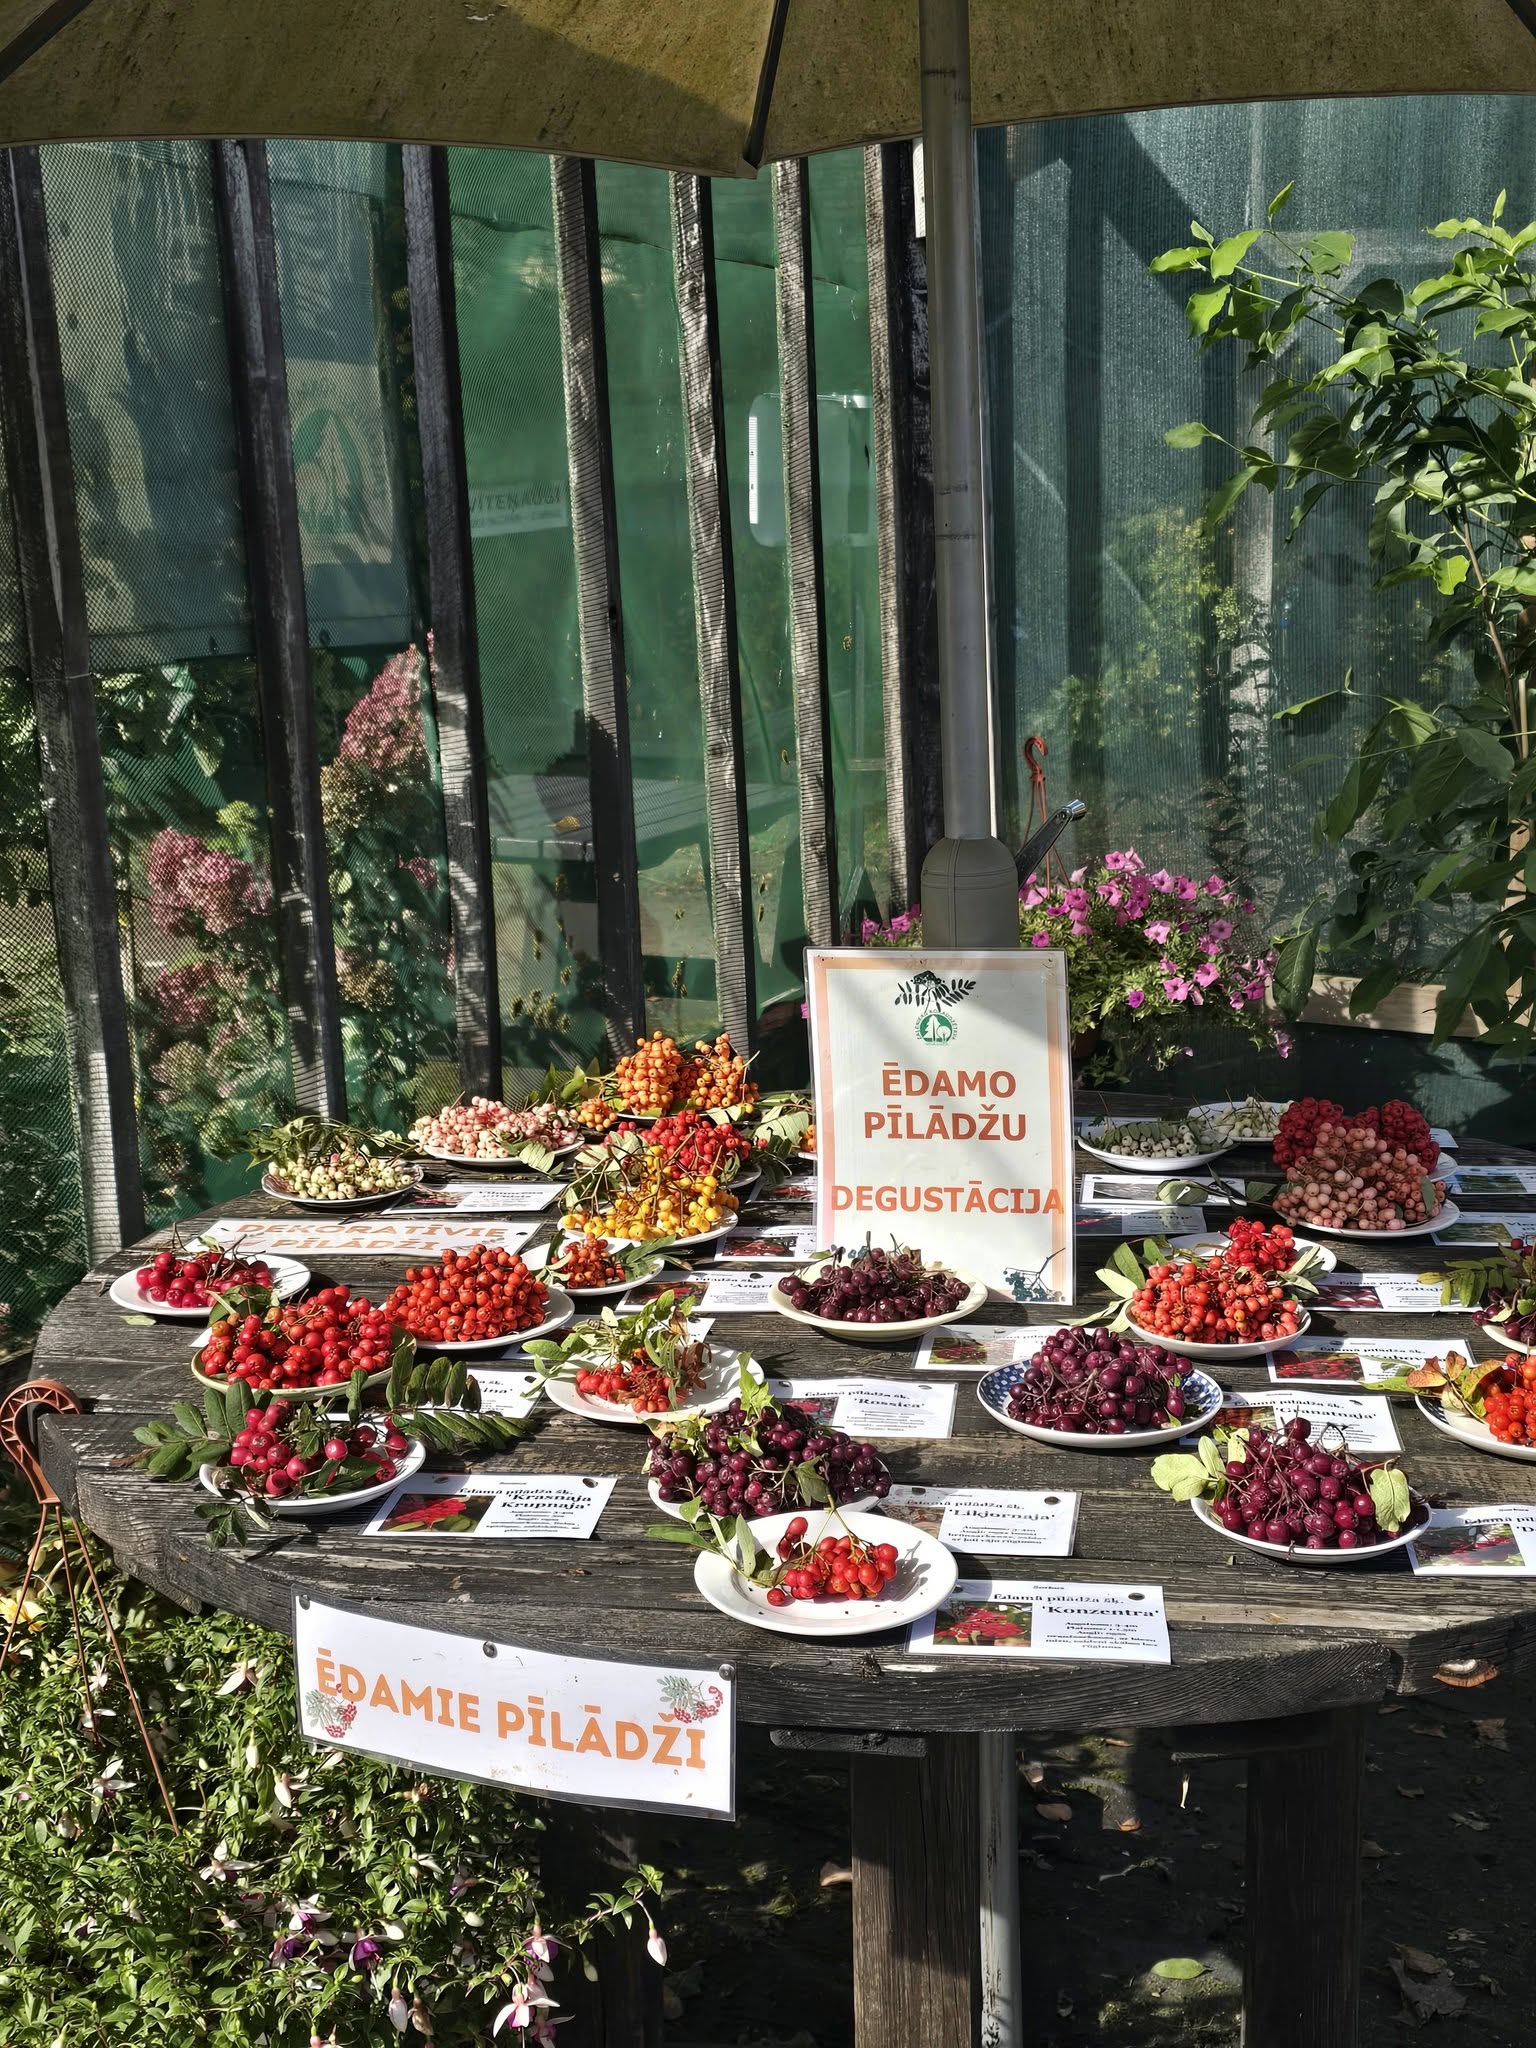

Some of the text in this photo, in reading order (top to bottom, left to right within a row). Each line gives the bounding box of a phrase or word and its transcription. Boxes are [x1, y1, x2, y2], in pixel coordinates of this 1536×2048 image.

[881, 1062, 1016, 1098] ĒDAMO
[864, 1104, 1026, 1141] PĪLĀDŽU
[831, 1180, 1064, 1215] DEGUSTĀCIJA
[236, 1223, 509, 1238] DEKORATĪVIE
[271, 1237, 440, 1251] PĪLĀDŽI
[854, 1398, 925, 1408] 'Rossica'
[501, 1501, 591, 1509] Krupnaja'
[508, 1494, 592, 1503] 'Krasnaja
[949, 1508, 1056, 1521] 'Likjornaja'
[993, 1592, 1043, 1601] Ēdamā
[1047, 1595, 1100, 1604] pīlādža
[1042, 1606, 1160, 1617] 'Konzentra'
[316, 1648, 706, 1769] ĒDAMIE PĪLĀDŽI
